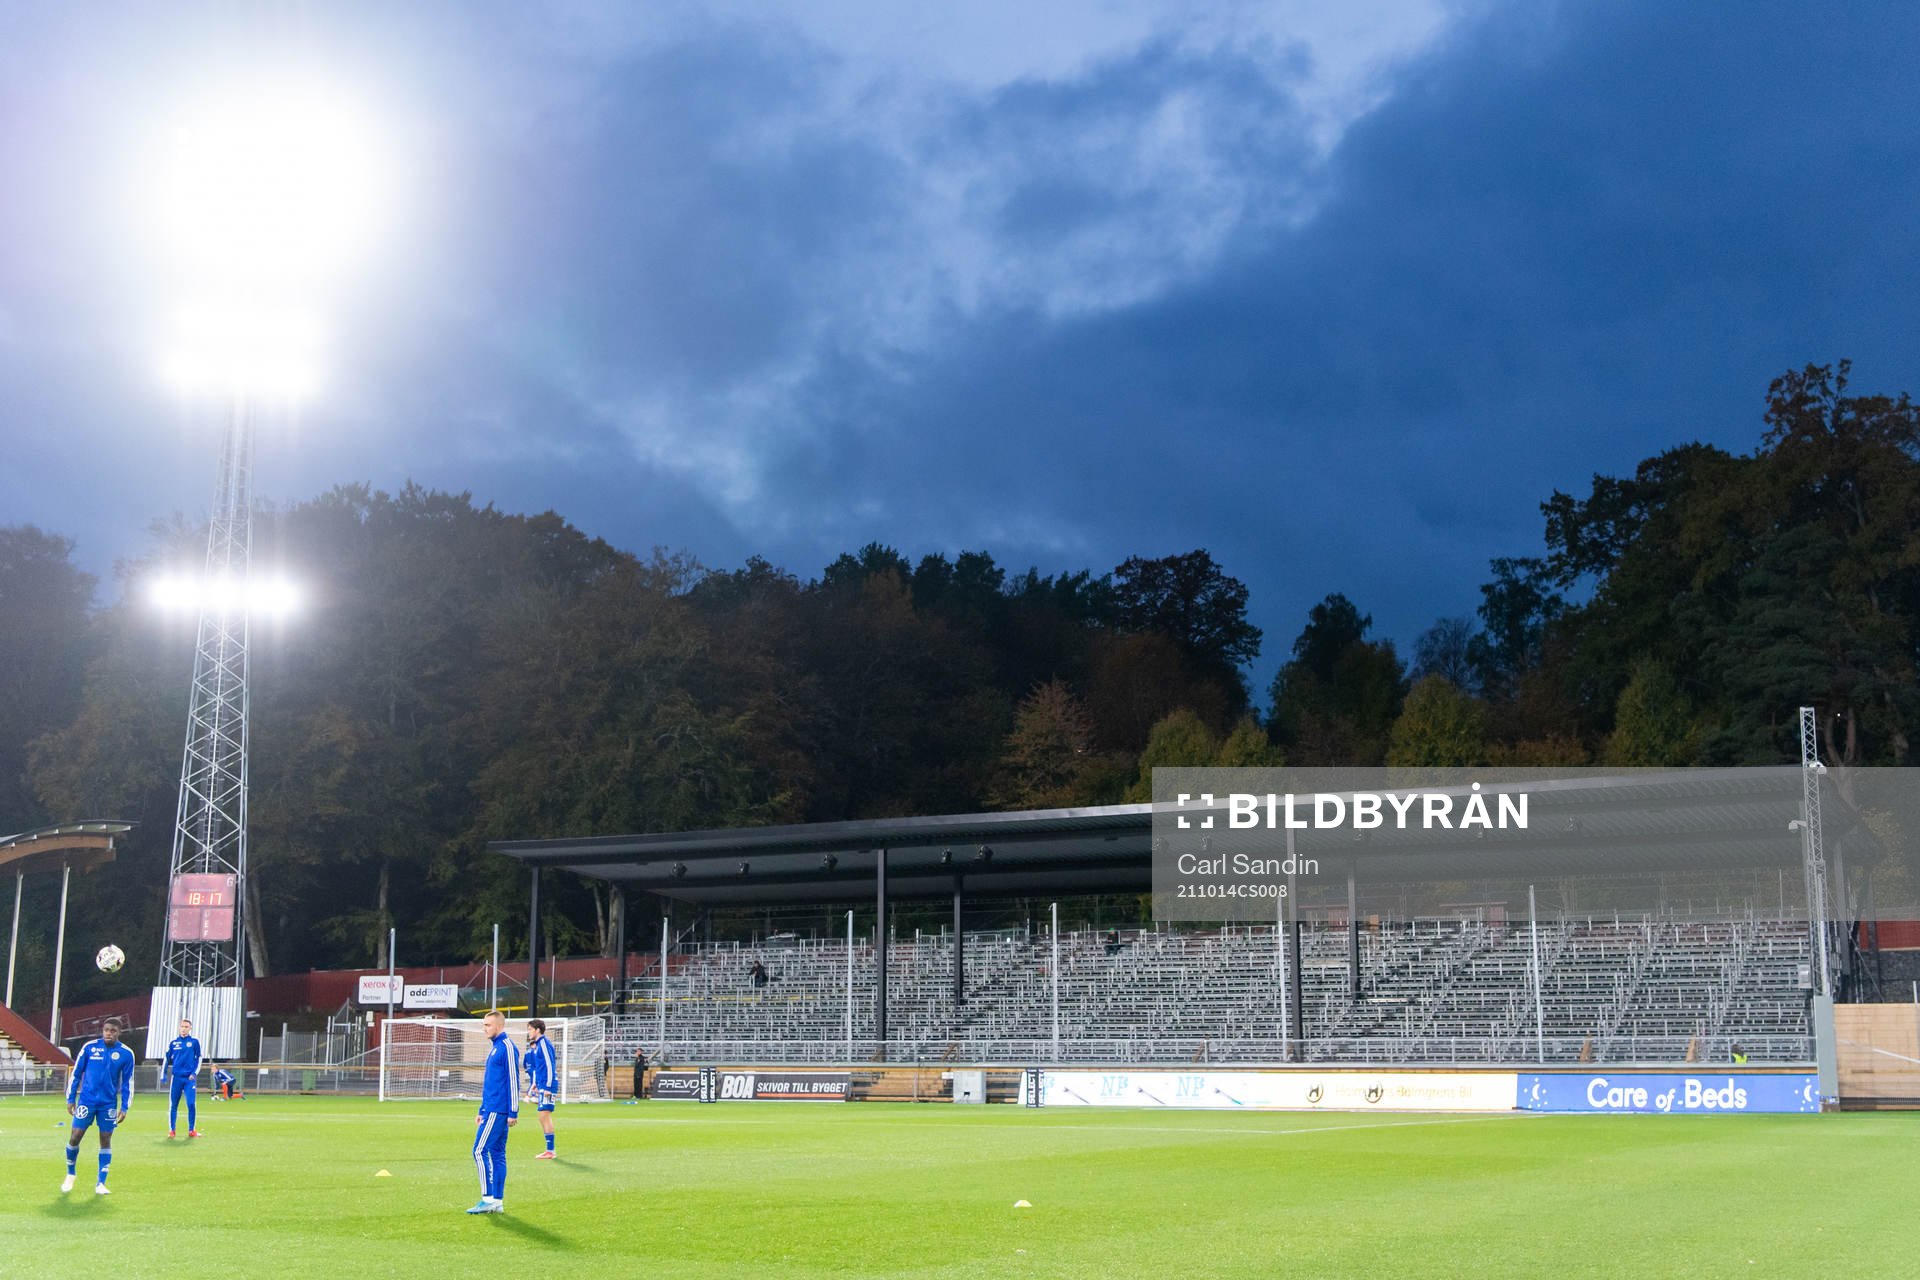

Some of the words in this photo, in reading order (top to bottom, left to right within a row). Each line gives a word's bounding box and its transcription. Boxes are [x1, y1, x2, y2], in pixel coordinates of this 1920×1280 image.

[188, 892, 222, 905] 18:17
[363, 981, 387, 989] xerox
[700, 1071, 708, 1100] SELECT
[720, 1075, 755, 1098] BOA
[756, 1082, 790, 1092] SKIVOR
[792, 1082, 810, 1092] TILL
[812, 1082, 848, 1092] BYGGET
[1028, 1073, 1036, 1104] SELECT
[1587, 1078, 1648, 1108] Care
[1655, 1088, 1676, 1112] of
[1684, 1078, 1747, 1109] Beds
